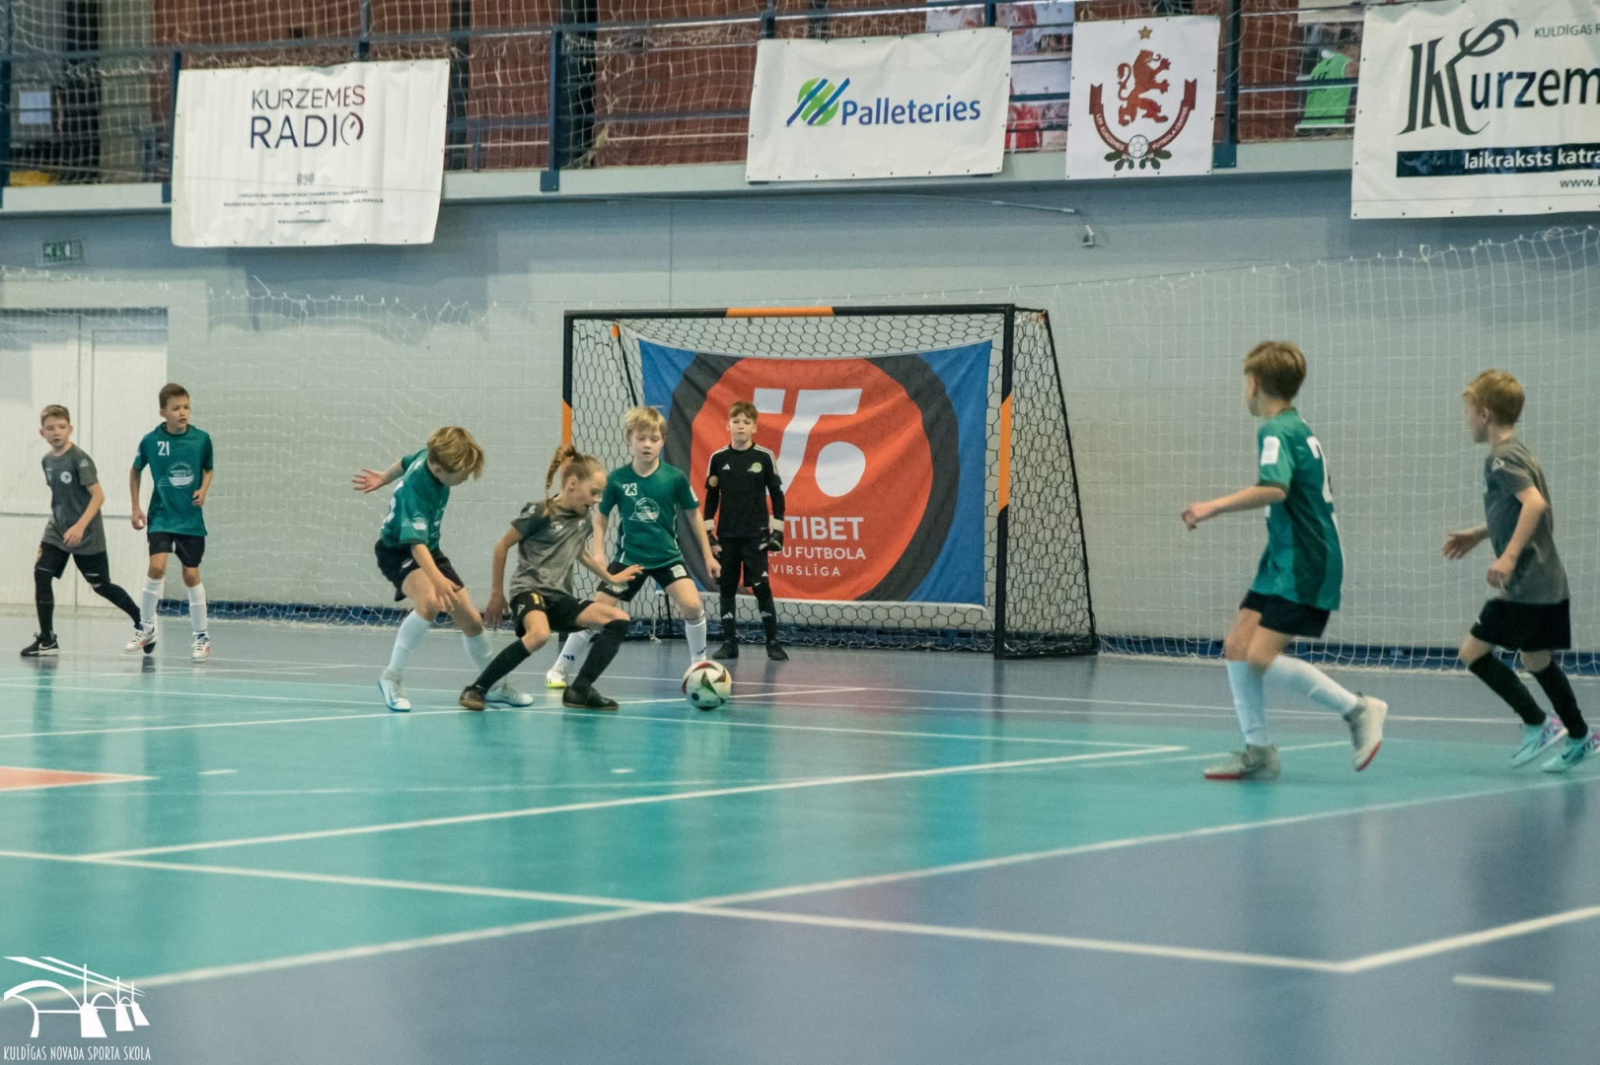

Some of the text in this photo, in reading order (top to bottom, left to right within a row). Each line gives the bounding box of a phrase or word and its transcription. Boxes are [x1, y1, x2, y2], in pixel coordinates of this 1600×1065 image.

[251, 85, 366, 110] KURZEMES
[841, 94, 981, 126] Palleteries
[250, 112, 364, 149] RADIO
[1464, 150, 1553, 170] laikraksts
[157, 440, 170, 456] 21
[622, 482, 638, 497] 23
[769, 515, 864, 541] TIBET
[795, 546, 866, 560] FUTBOLA
[771, 563, 841, 577] VIRSLĪGA
